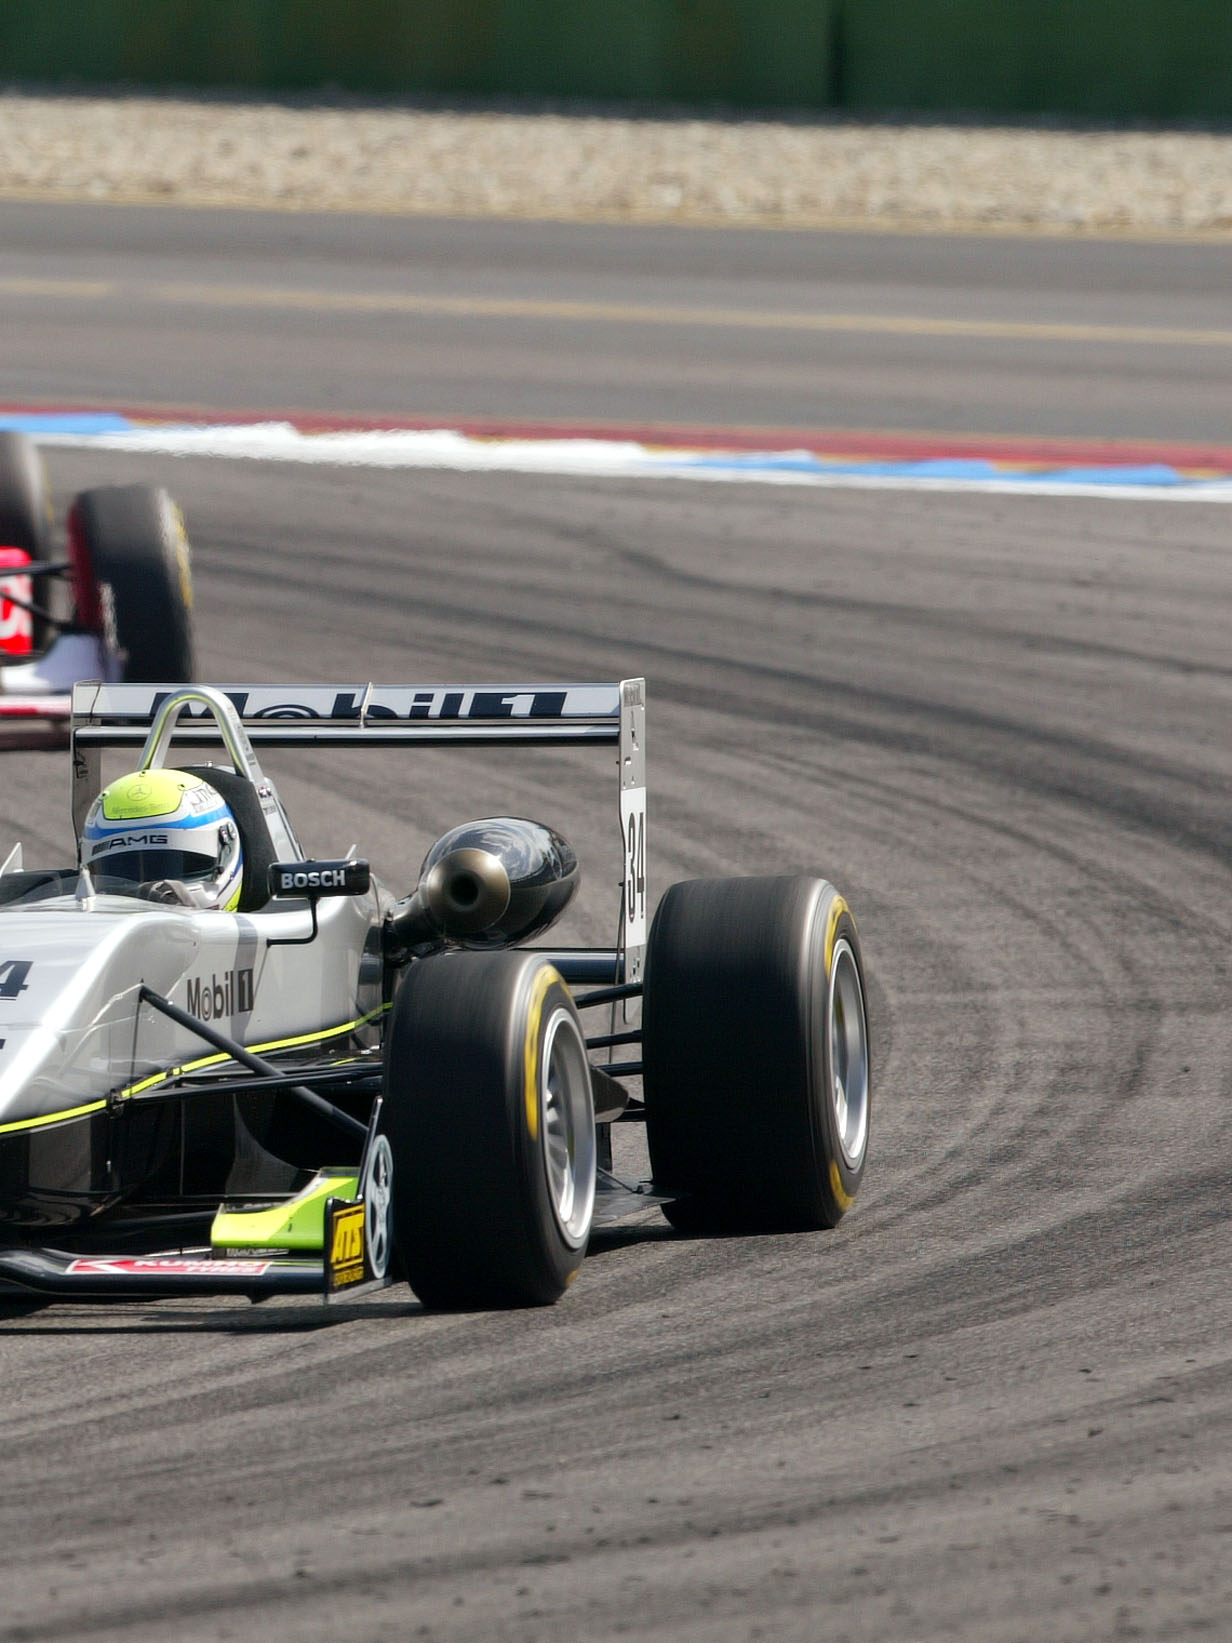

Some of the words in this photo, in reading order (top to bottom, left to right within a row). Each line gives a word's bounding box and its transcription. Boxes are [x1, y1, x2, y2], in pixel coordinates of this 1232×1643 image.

[109, 834, 168, 849] AMG
[281, 869, 346, 889] BOSCH
[627, 812, 645, 924] 34
[186, 970, 235, 1022] Mobil
[330, 1211, 366, 1264] ATS
[133, 1259, 266, 1268] KUMHO
